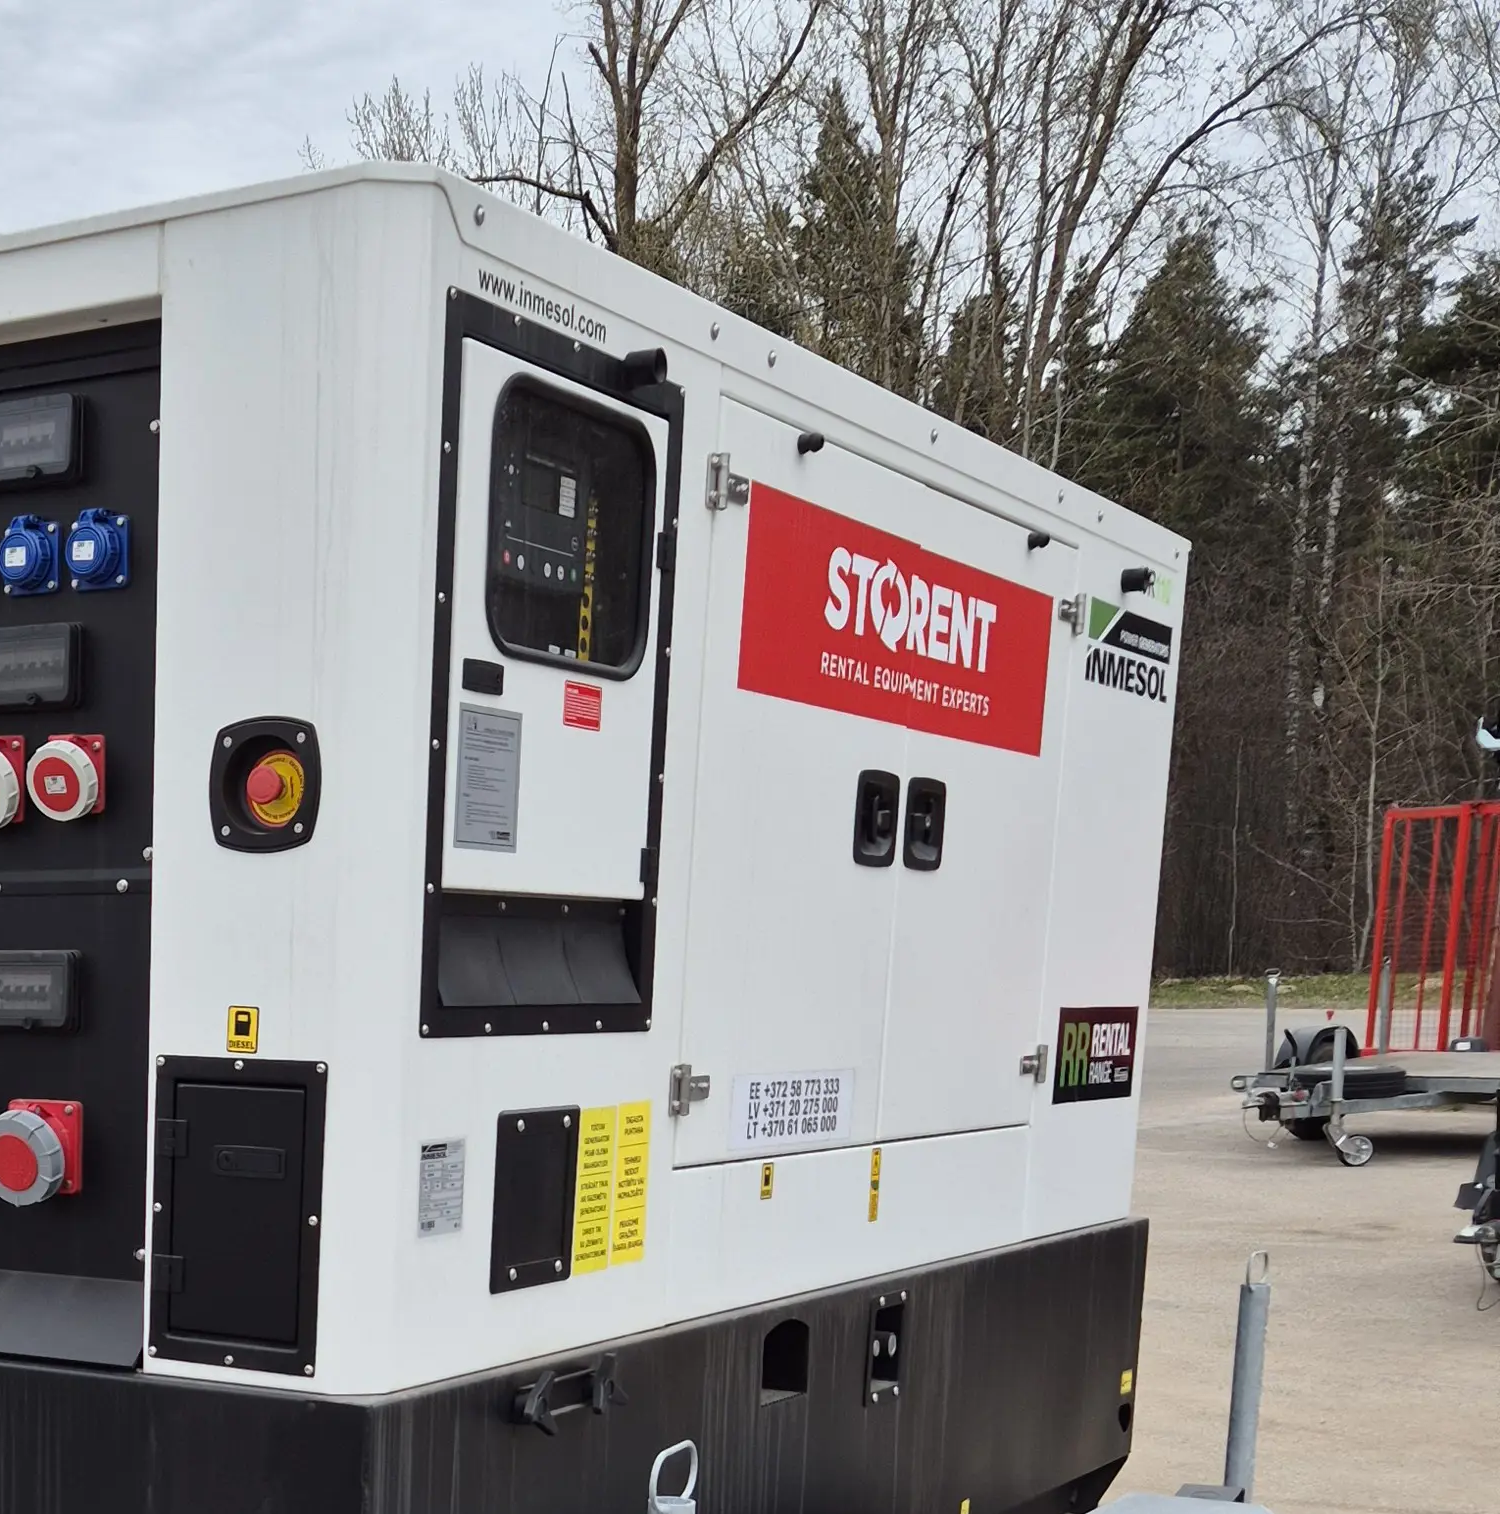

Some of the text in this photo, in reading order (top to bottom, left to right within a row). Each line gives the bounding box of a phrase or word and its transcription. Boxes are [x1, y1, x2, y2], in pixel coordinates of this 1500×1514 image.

[478, 269, 607, 344] www.inmesol.com
[824, 546, 998, 673] STORENT
[820, 651, 870, 686] RENTAL
[942, 685, 990, 717] EXPERTS
[1085, 644, 1167, 703] INMESOL
[228, 1040, 255, 1050] DIESEL
[1060, 1022, 1091, 1088] RR
[1090, 1022, 1131, 1057] RENTAL
[749, 1078, 840, 1100] EE +372 58 773 333
[1088, 1060, 1113, 1084] RANGE
[748, 1096, 838, 1120] LV +371 20 275 000
[747, 1115, 837, 1140] LT +370 61 065 000
